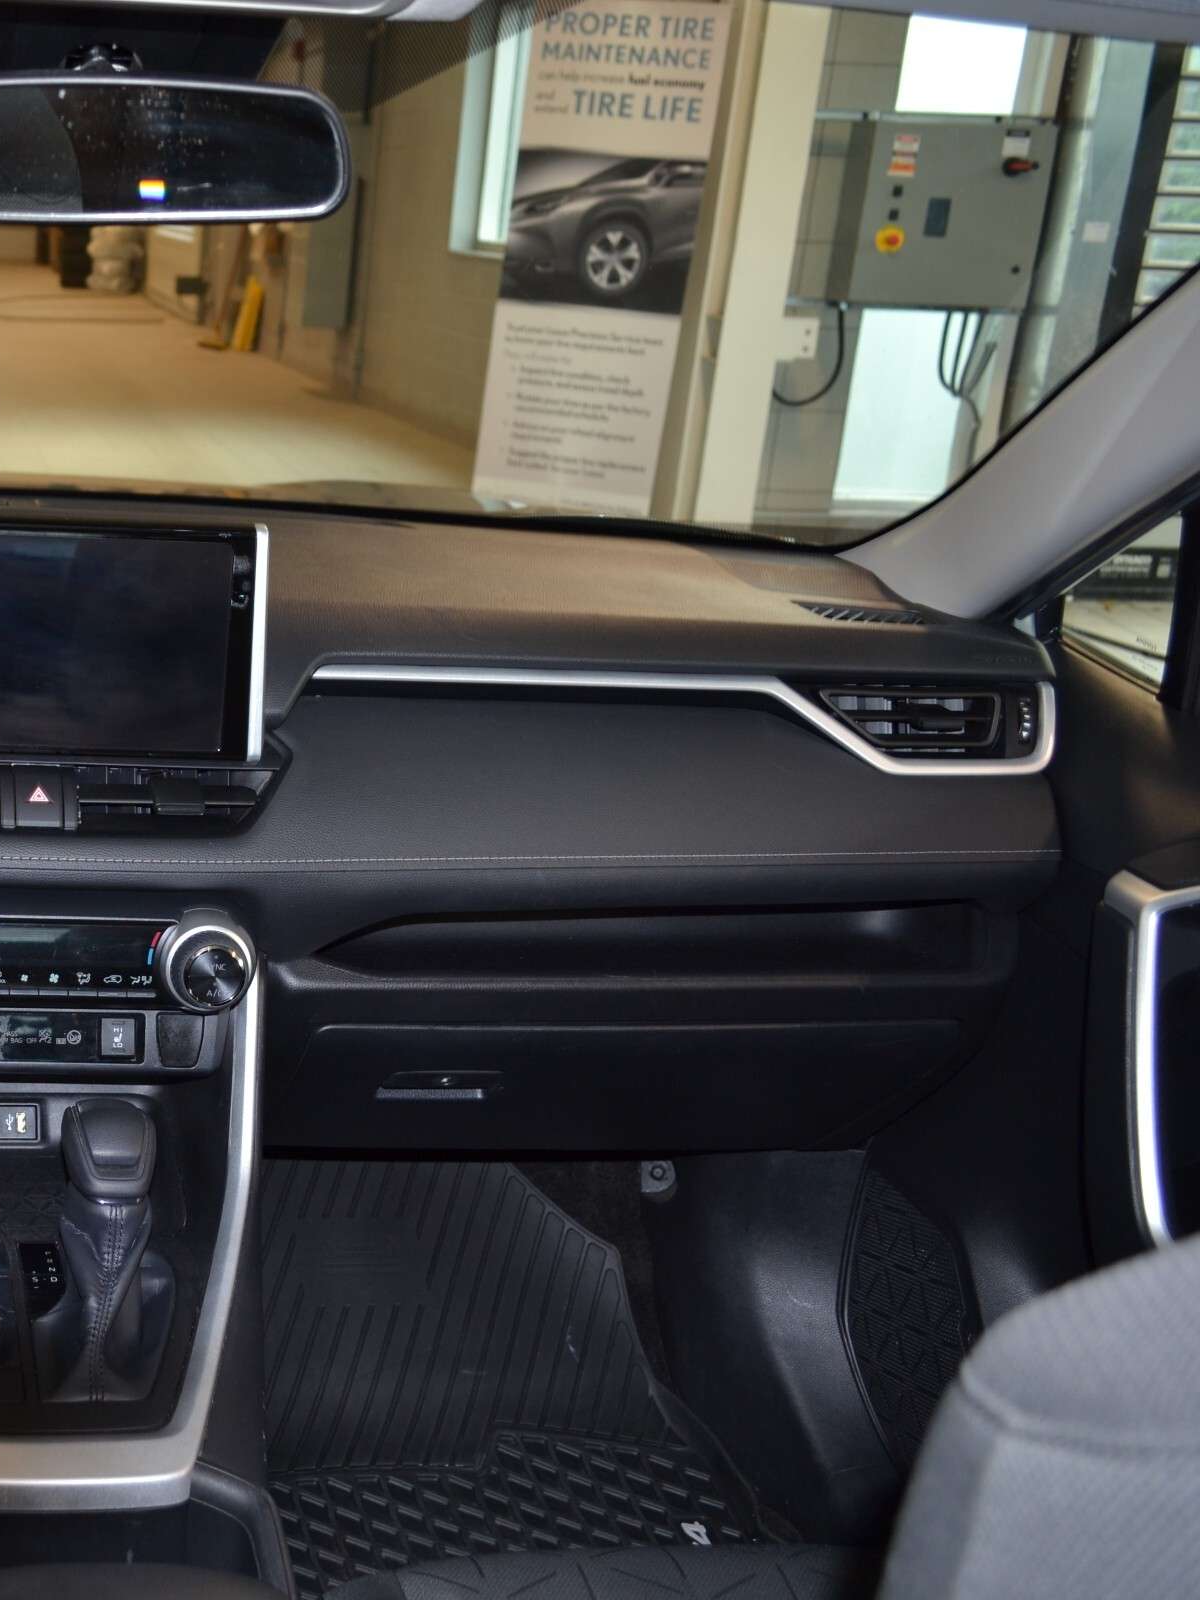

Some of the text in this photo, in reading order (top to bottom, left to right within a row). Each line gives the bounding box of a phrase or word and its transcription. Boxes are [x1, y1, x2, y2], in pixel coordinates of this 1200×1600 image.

[544, 11, 715, 41] PROPER TIRE
[541, 41, 711, 70] MAINTENANCE
[628, 74, 651, 87] fuel
[653, 78, 706, 90] economy
[574, 89, 703, 123] TIRE LIFE
